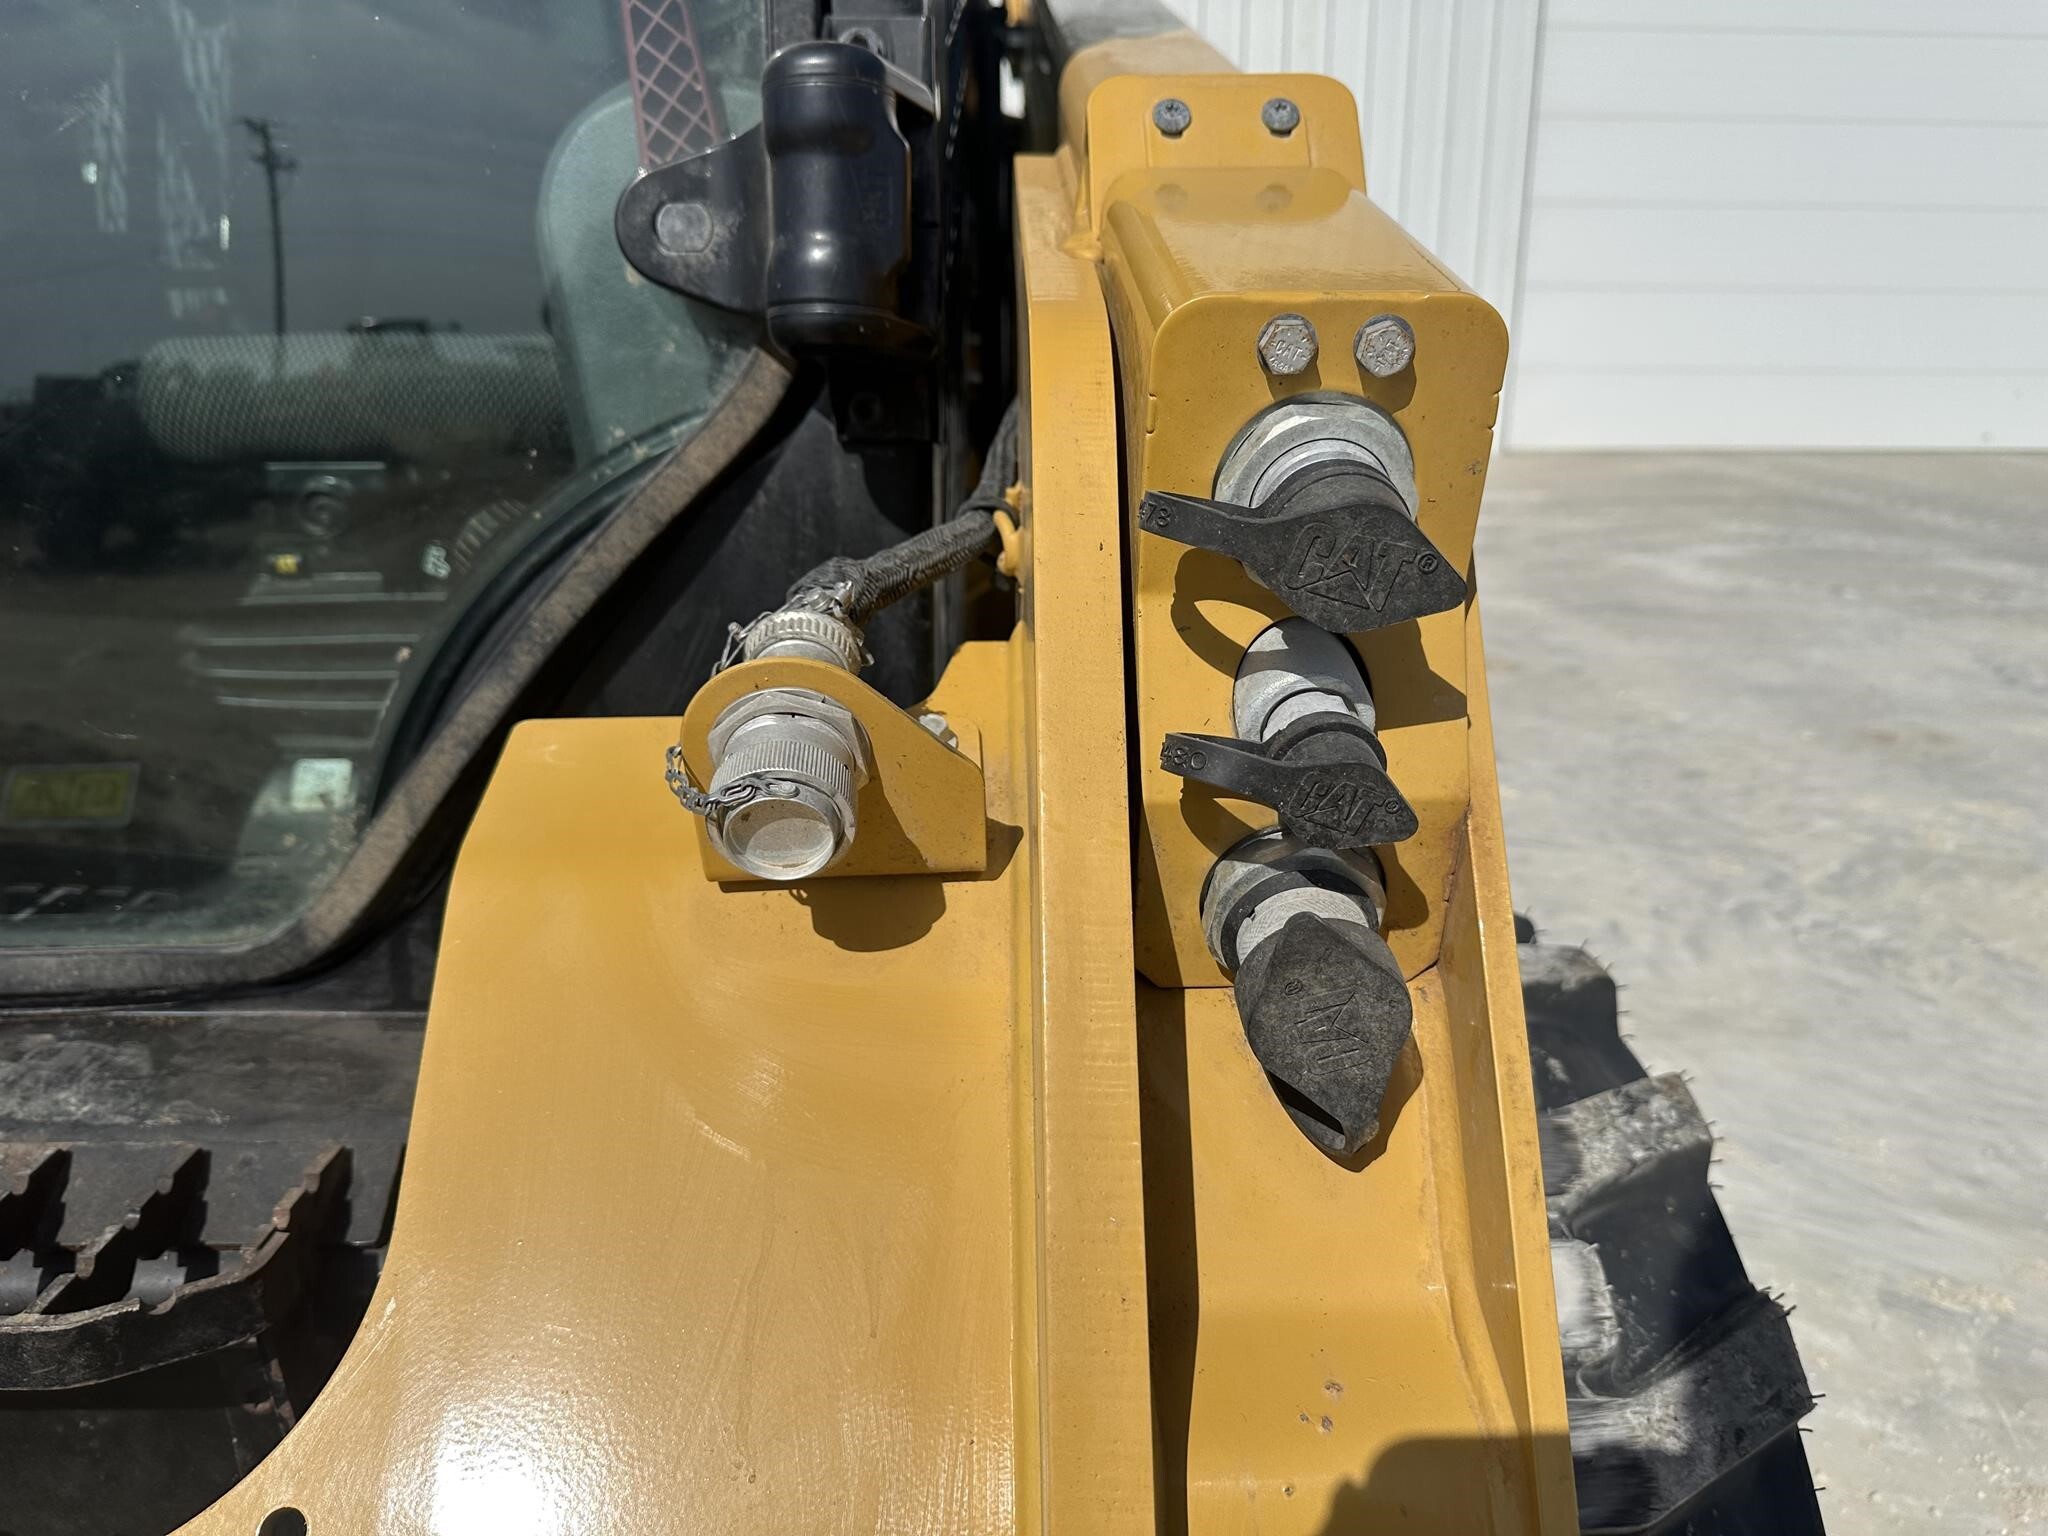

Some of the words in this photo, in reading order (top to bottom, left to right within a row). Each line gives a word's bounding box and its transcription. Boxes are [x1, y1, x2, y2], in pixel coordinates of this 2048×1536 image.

[1275, 340, 1304, 361] CAT
[1284, 521, 1419, 613] CAT
[1288, 770, 1388, 837] CAT
